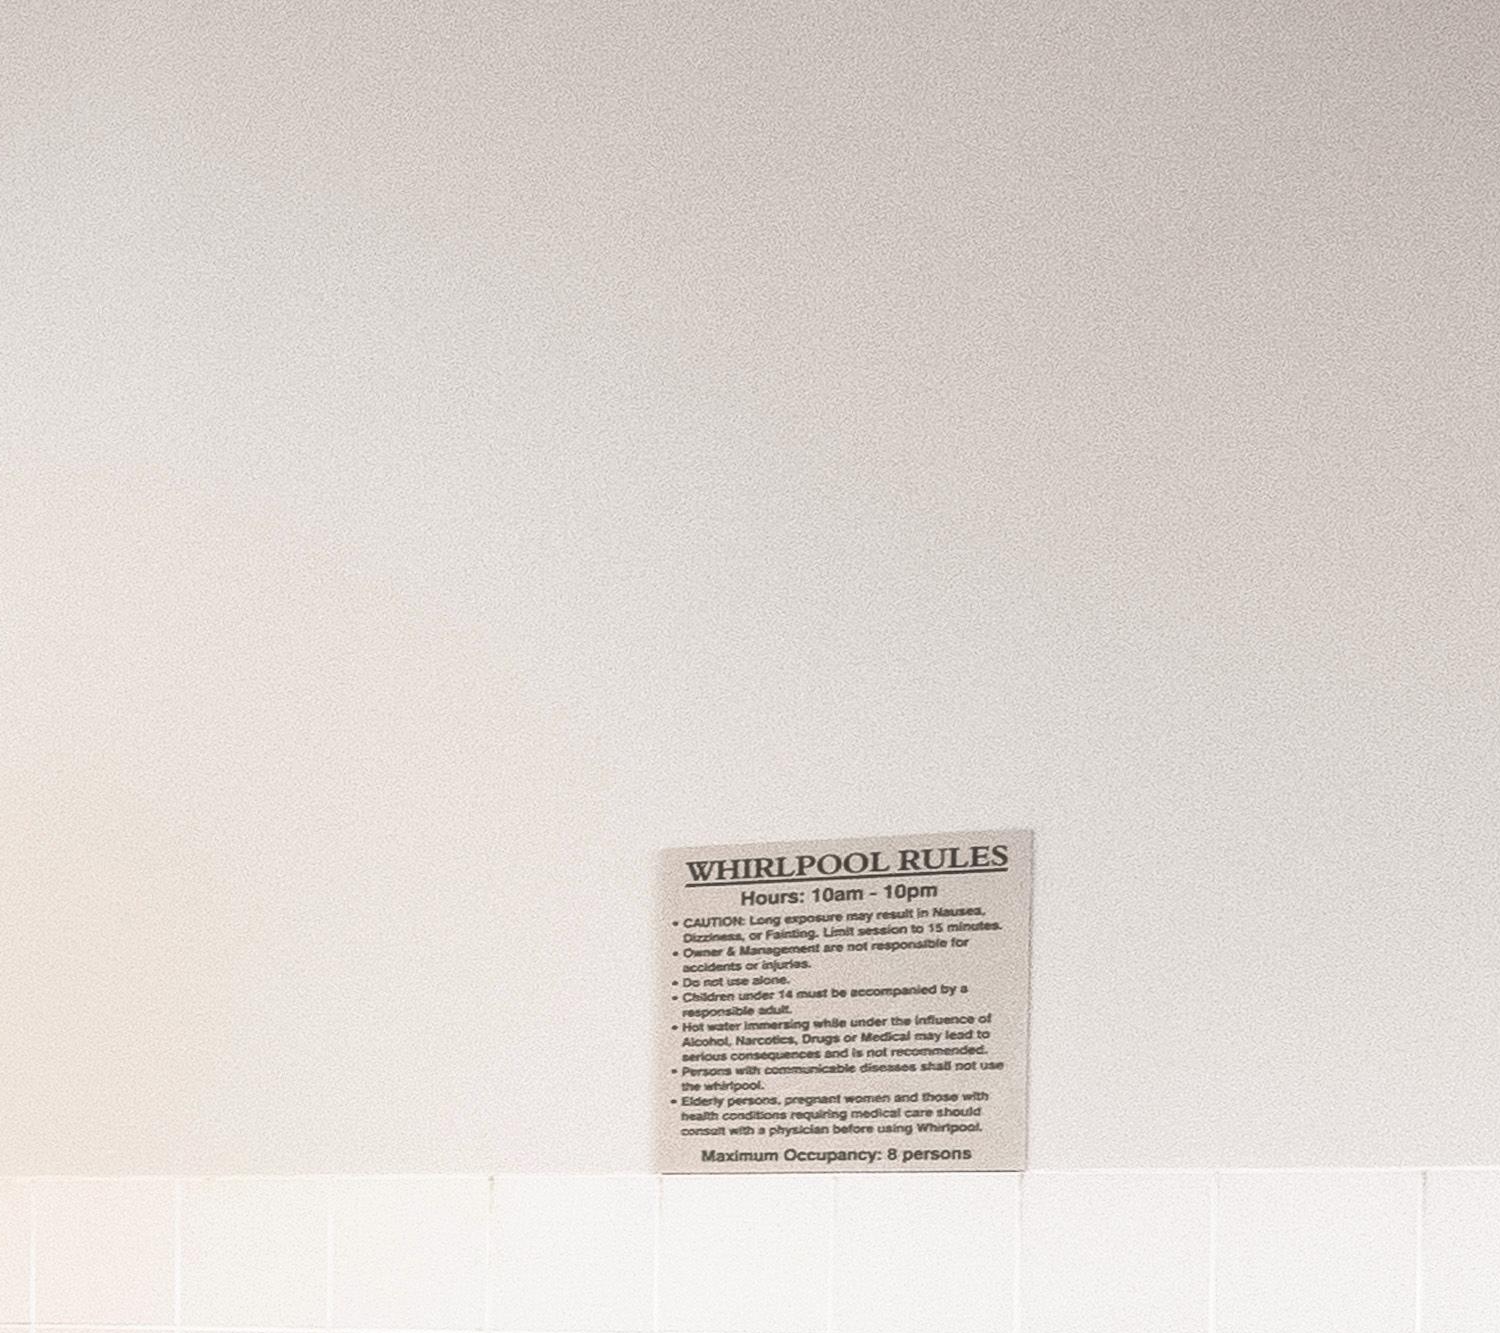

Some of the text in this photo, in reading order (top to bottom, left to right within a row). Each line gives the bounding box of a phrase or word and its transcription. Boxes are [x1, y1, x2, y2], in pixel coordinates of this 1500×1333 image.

[685, 845, 1008, 881] WHIRLPOOL RULES
[741, 891, 804, 906] Hours:
[812, 887, 864, 903] 10am
[884, 884, 938, 902] 10pm
[750, 915, 781, 927] Long
[785, 913, 843, 924] exposure
[846, 912, 873, 922] may
[877, 908, 913, 919] result
[917, 908, 928, 918] in
[749, 932, 761, 940] or
[823, 926, 854, 937] Limit
[858, 925, 907, 935] session
[911, 924, 924, 933] to
[929, 923, 943, 932] 15
[683, 948, 723, 958] Owner
[727, 947, 736, 956] &
[740, 943, 819, 956] Management
[847, 942, 868, 951] not
[871, 939, 947, 952] responsible
[952, 938, 969, 947] for
[683, 962, 742, 972] accidents
[746, 962, 758, 970] or
[683, 978, 699, 987] Do
[704, 978, 723, 987] not
[683, 984, 968, 1002] Children under 14 must be accompanied by a
[682, 1006, 754, 1019] responsible
[682, 1013, 991, 1032] Hot water immersing while under the influence of
[736, 1035, 798, 1046] Narcotics,
[802, 1033, 840, 1045] Drugs
[844, 1034, 857, 1042] or
[861, 1031, 910, 1042] Medical
[914, 1033, 942, 1042] may
[945, 1030, 972, 1040] lead
[977, 1030, 990, 1038] to
[682, 1052, 727, 1061] serious
[730, 1050, 821, 1061] consequences
[825, 1048, 848, 1058] and
[852, 1048, 863, 1057] is
[867, 1048, 887, 1057] not
[682, 1061, 1004, 1076] Persons with communicable diseases shall not use
[682, 1082, 700, 1091] the
[682, 1097, 723, 1108] Elderly
[785, 1095, 840, 1106] pregnant
[844, 1095, 891, 1103] women
[894, 1093, 918, 1102] and
[922, 1092, 958, 1101] those
[962, 1092, 989, 1101] with
[682, 1107, 981, 1121] health conditions requiring medical care should
[681, 1127, 725, 1136] consult
[729, 1126, 755, 1135] with
[769, 1125, 829, 1137] physician
[833, 1125, 873, 1134] before
[877, 1124, 912, 1135] using
[701, 1148, 972, 1163] Maximum Occupancy: 8 persons
